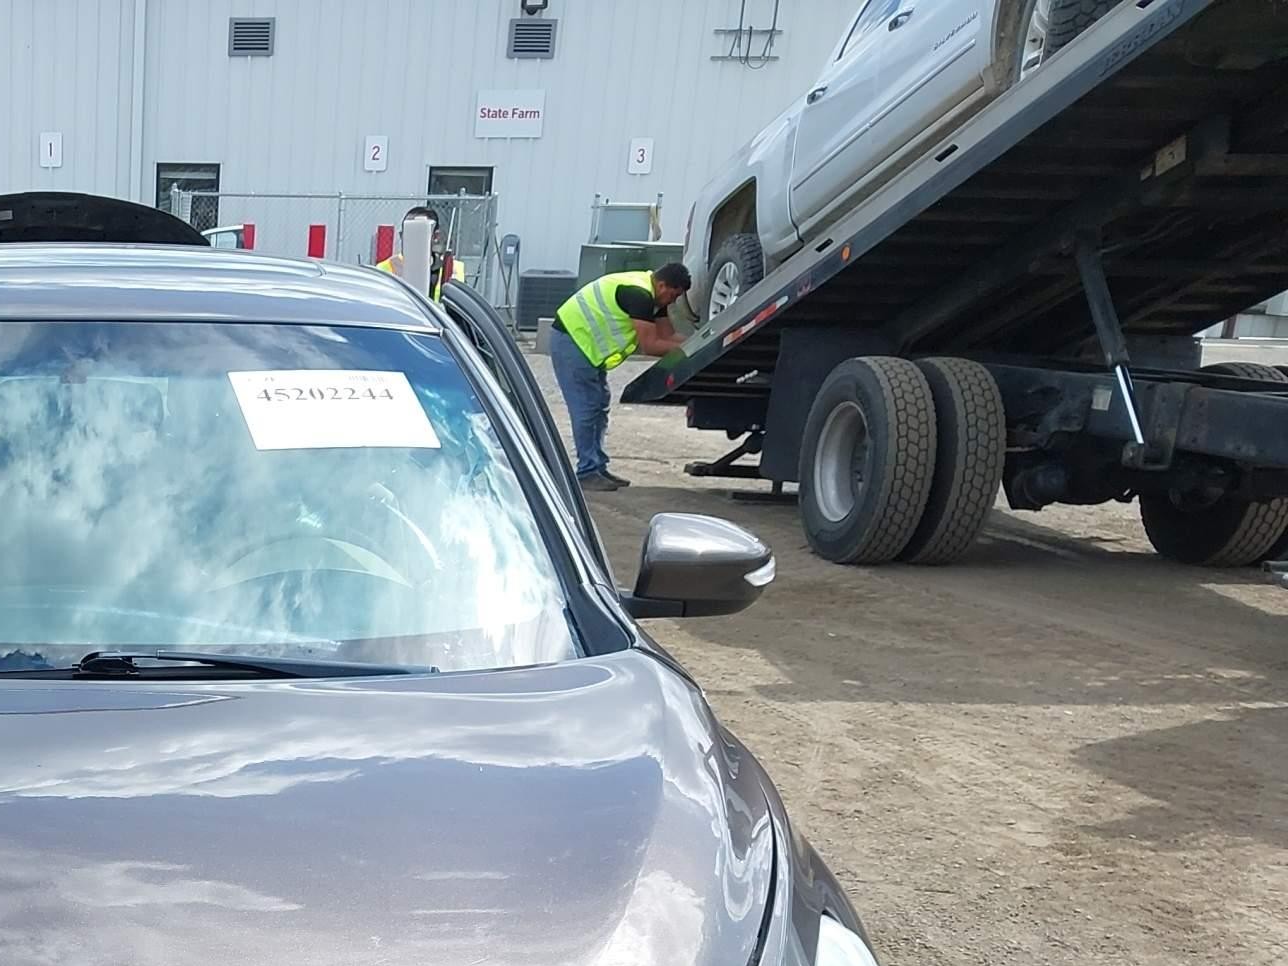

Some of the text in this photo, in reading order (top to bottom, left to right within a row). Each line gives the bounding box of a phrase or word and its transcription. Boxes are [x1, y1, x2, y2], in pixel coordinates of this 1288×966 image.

[479, 107, 540, 119] State Farm
[372, 145, 380, 161] 2
[636, 148, 645, 163] 3
[256, 387, 394, 402] 45202244
